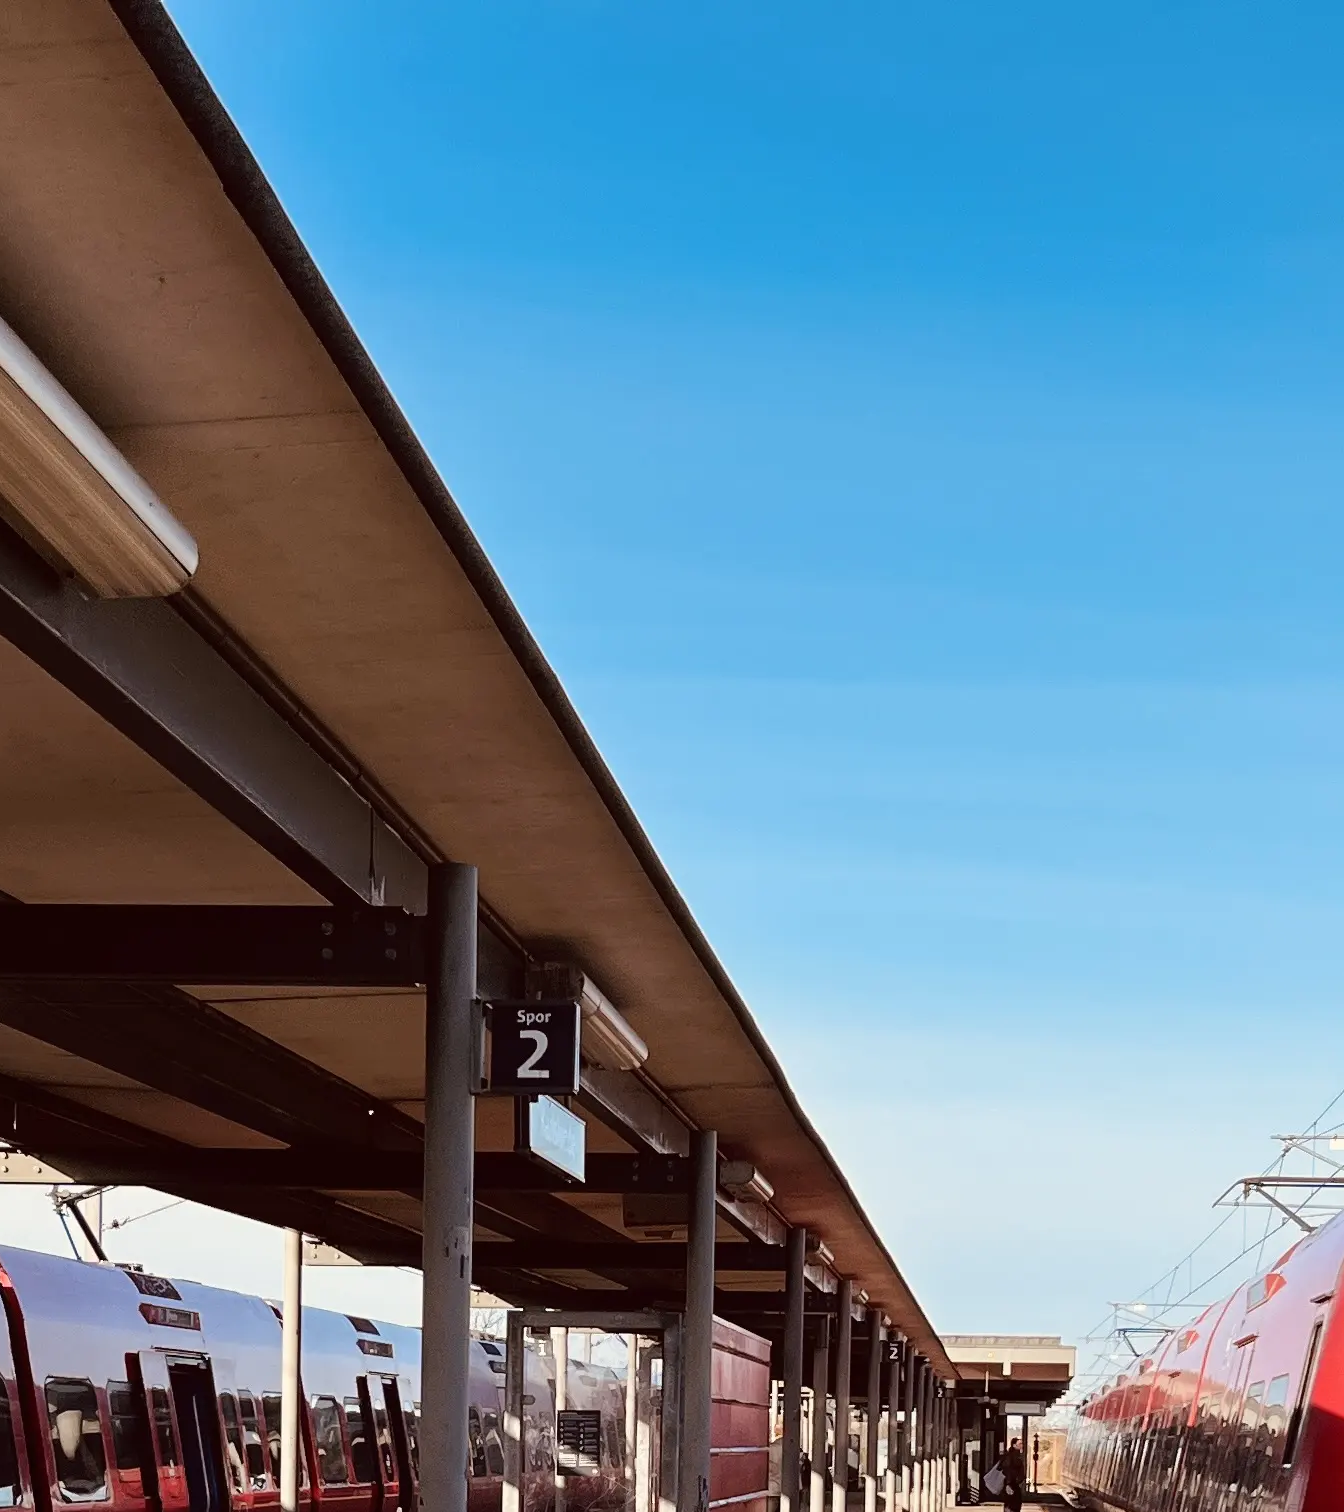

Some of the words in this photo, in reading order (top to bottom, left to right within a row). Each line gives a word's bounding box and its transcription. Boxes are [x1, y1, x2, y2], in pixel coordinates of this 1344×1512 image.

[517, 1009, 552, 1026] Spor
[517, 1029, 550, 1079] 2
[889, 1347, 899, 1360] 2
